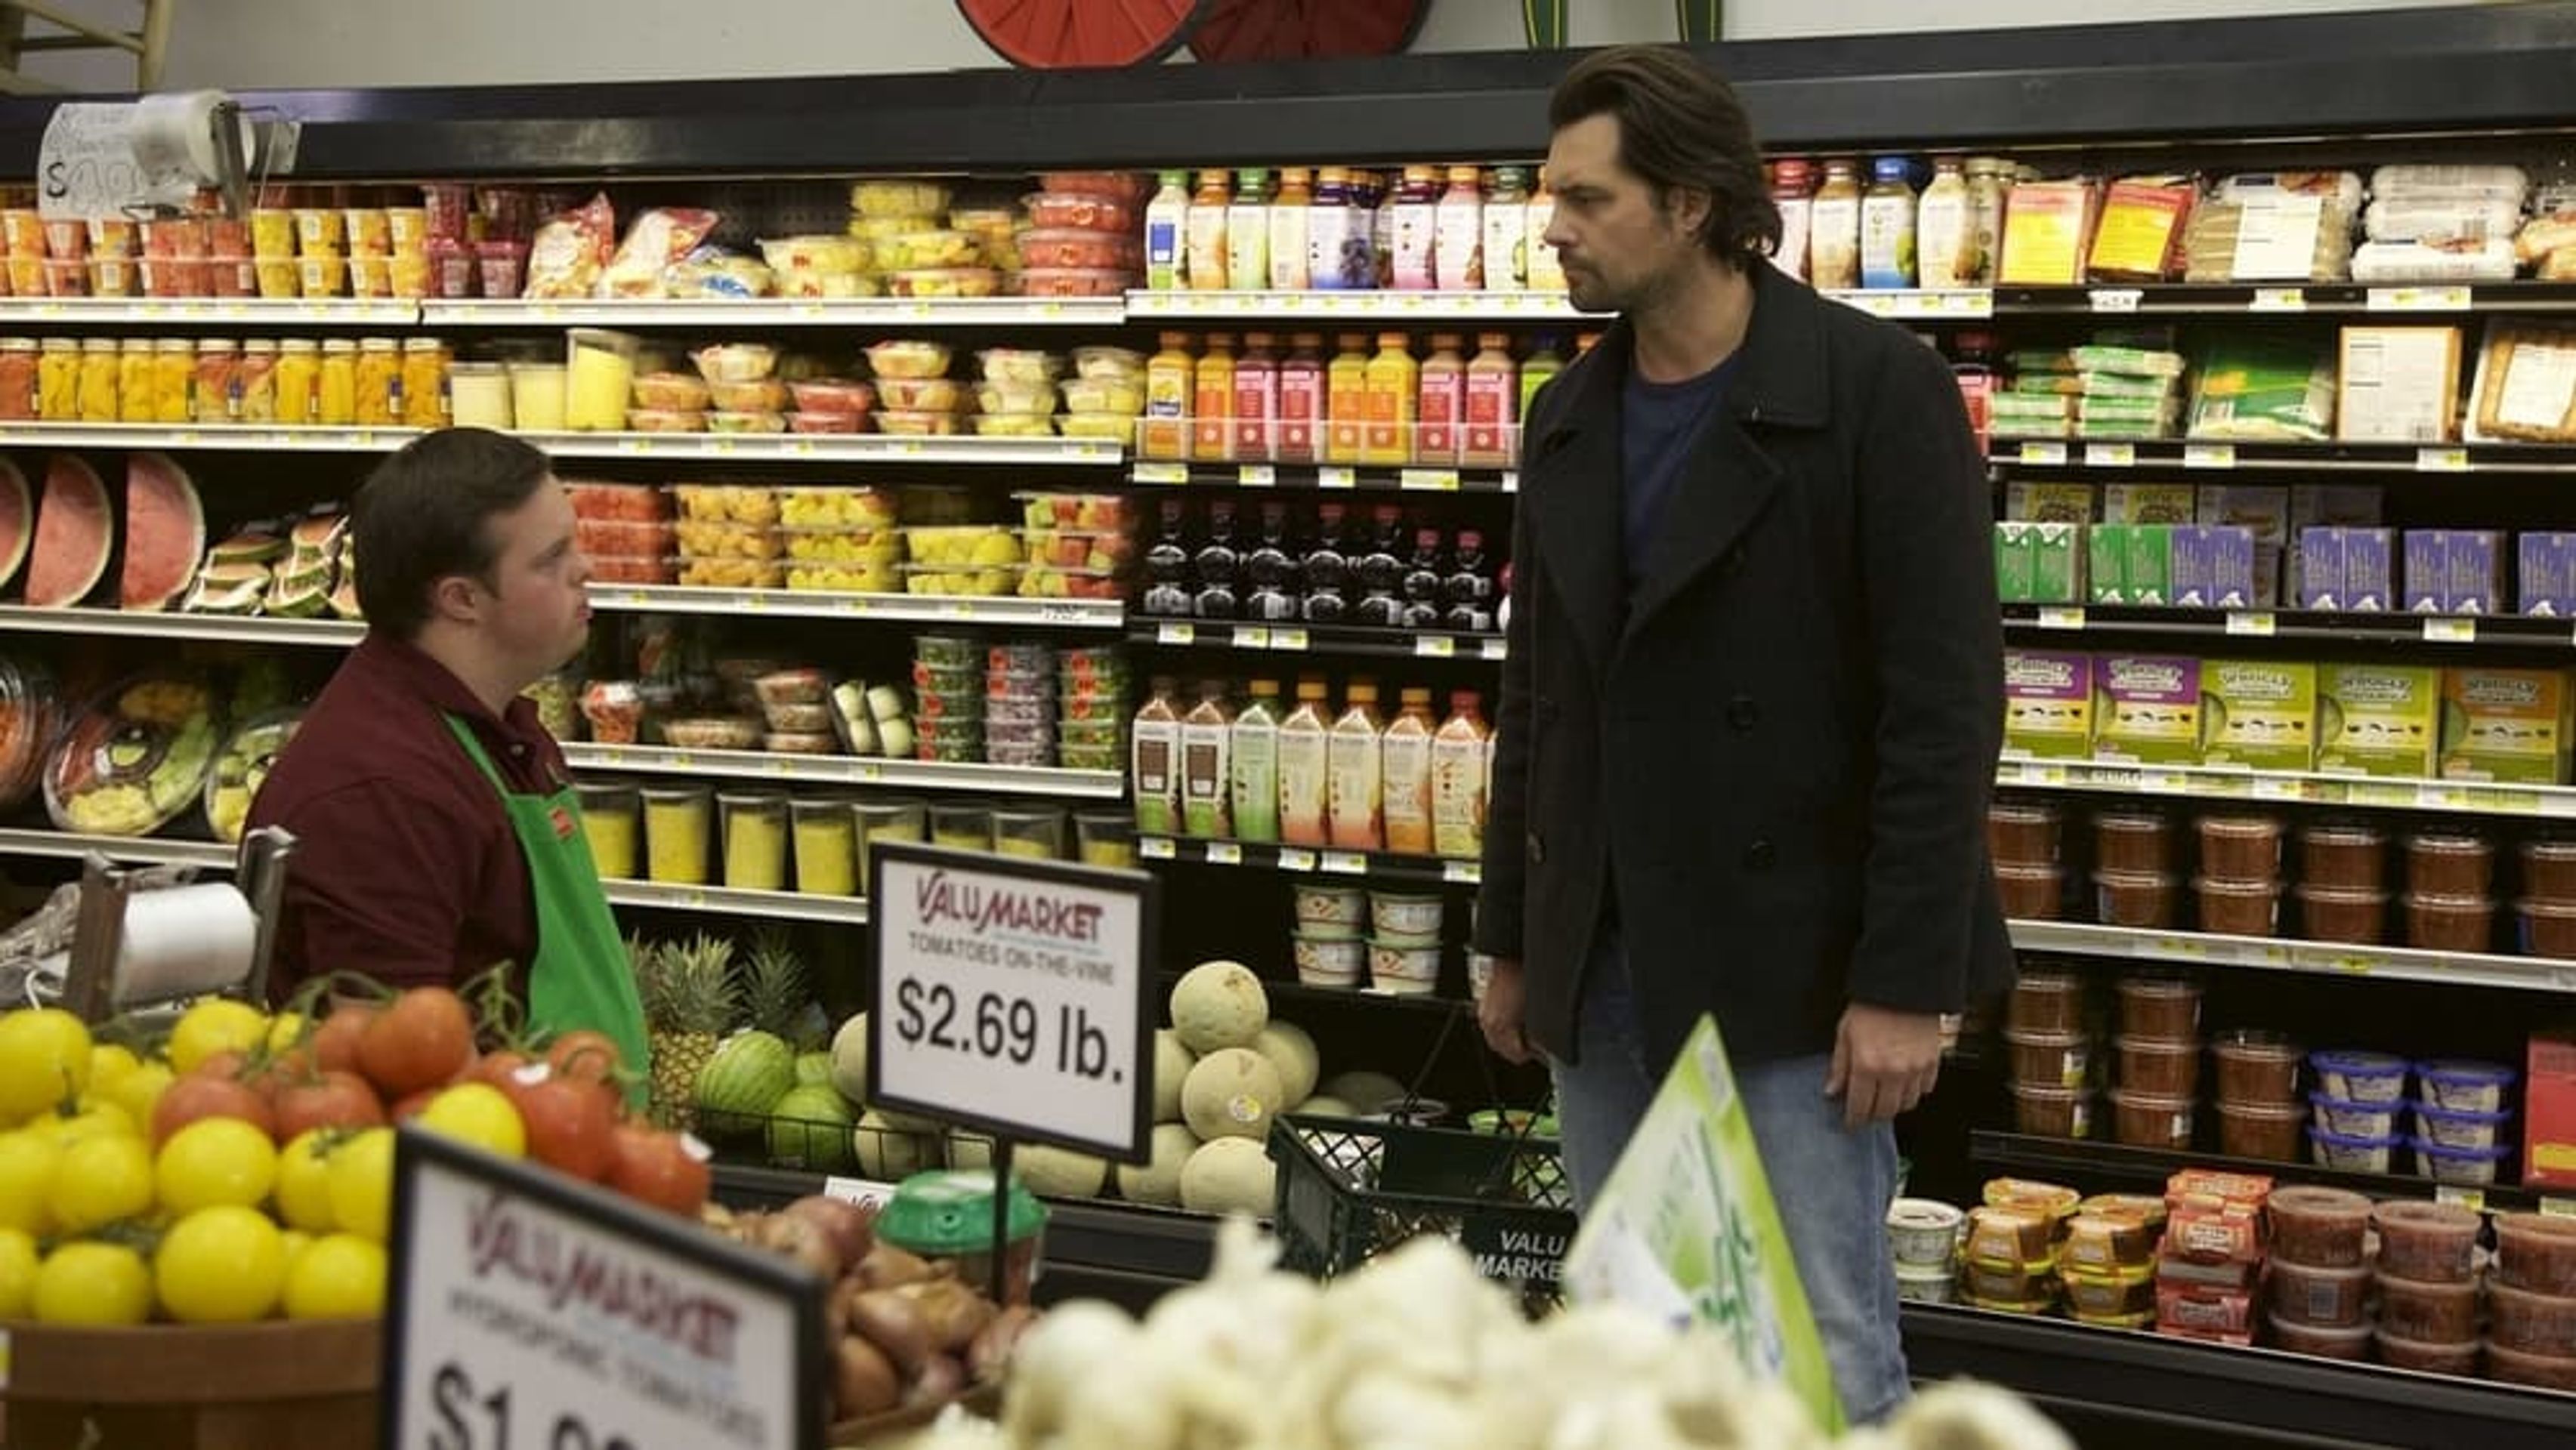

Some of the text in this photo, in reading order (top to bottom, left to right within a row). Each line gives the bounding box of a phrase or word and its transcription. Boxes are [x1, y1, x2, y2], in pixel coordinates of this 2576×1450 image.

[909, 932, 1114, 986] TOMATOES ON-THE-VINE
[897, 976, 1123, 1084] $2.69 lb.
[1500, 1230, 1566, 1255] VALU
[1475, 1254, 1567, 1282] MARKE
